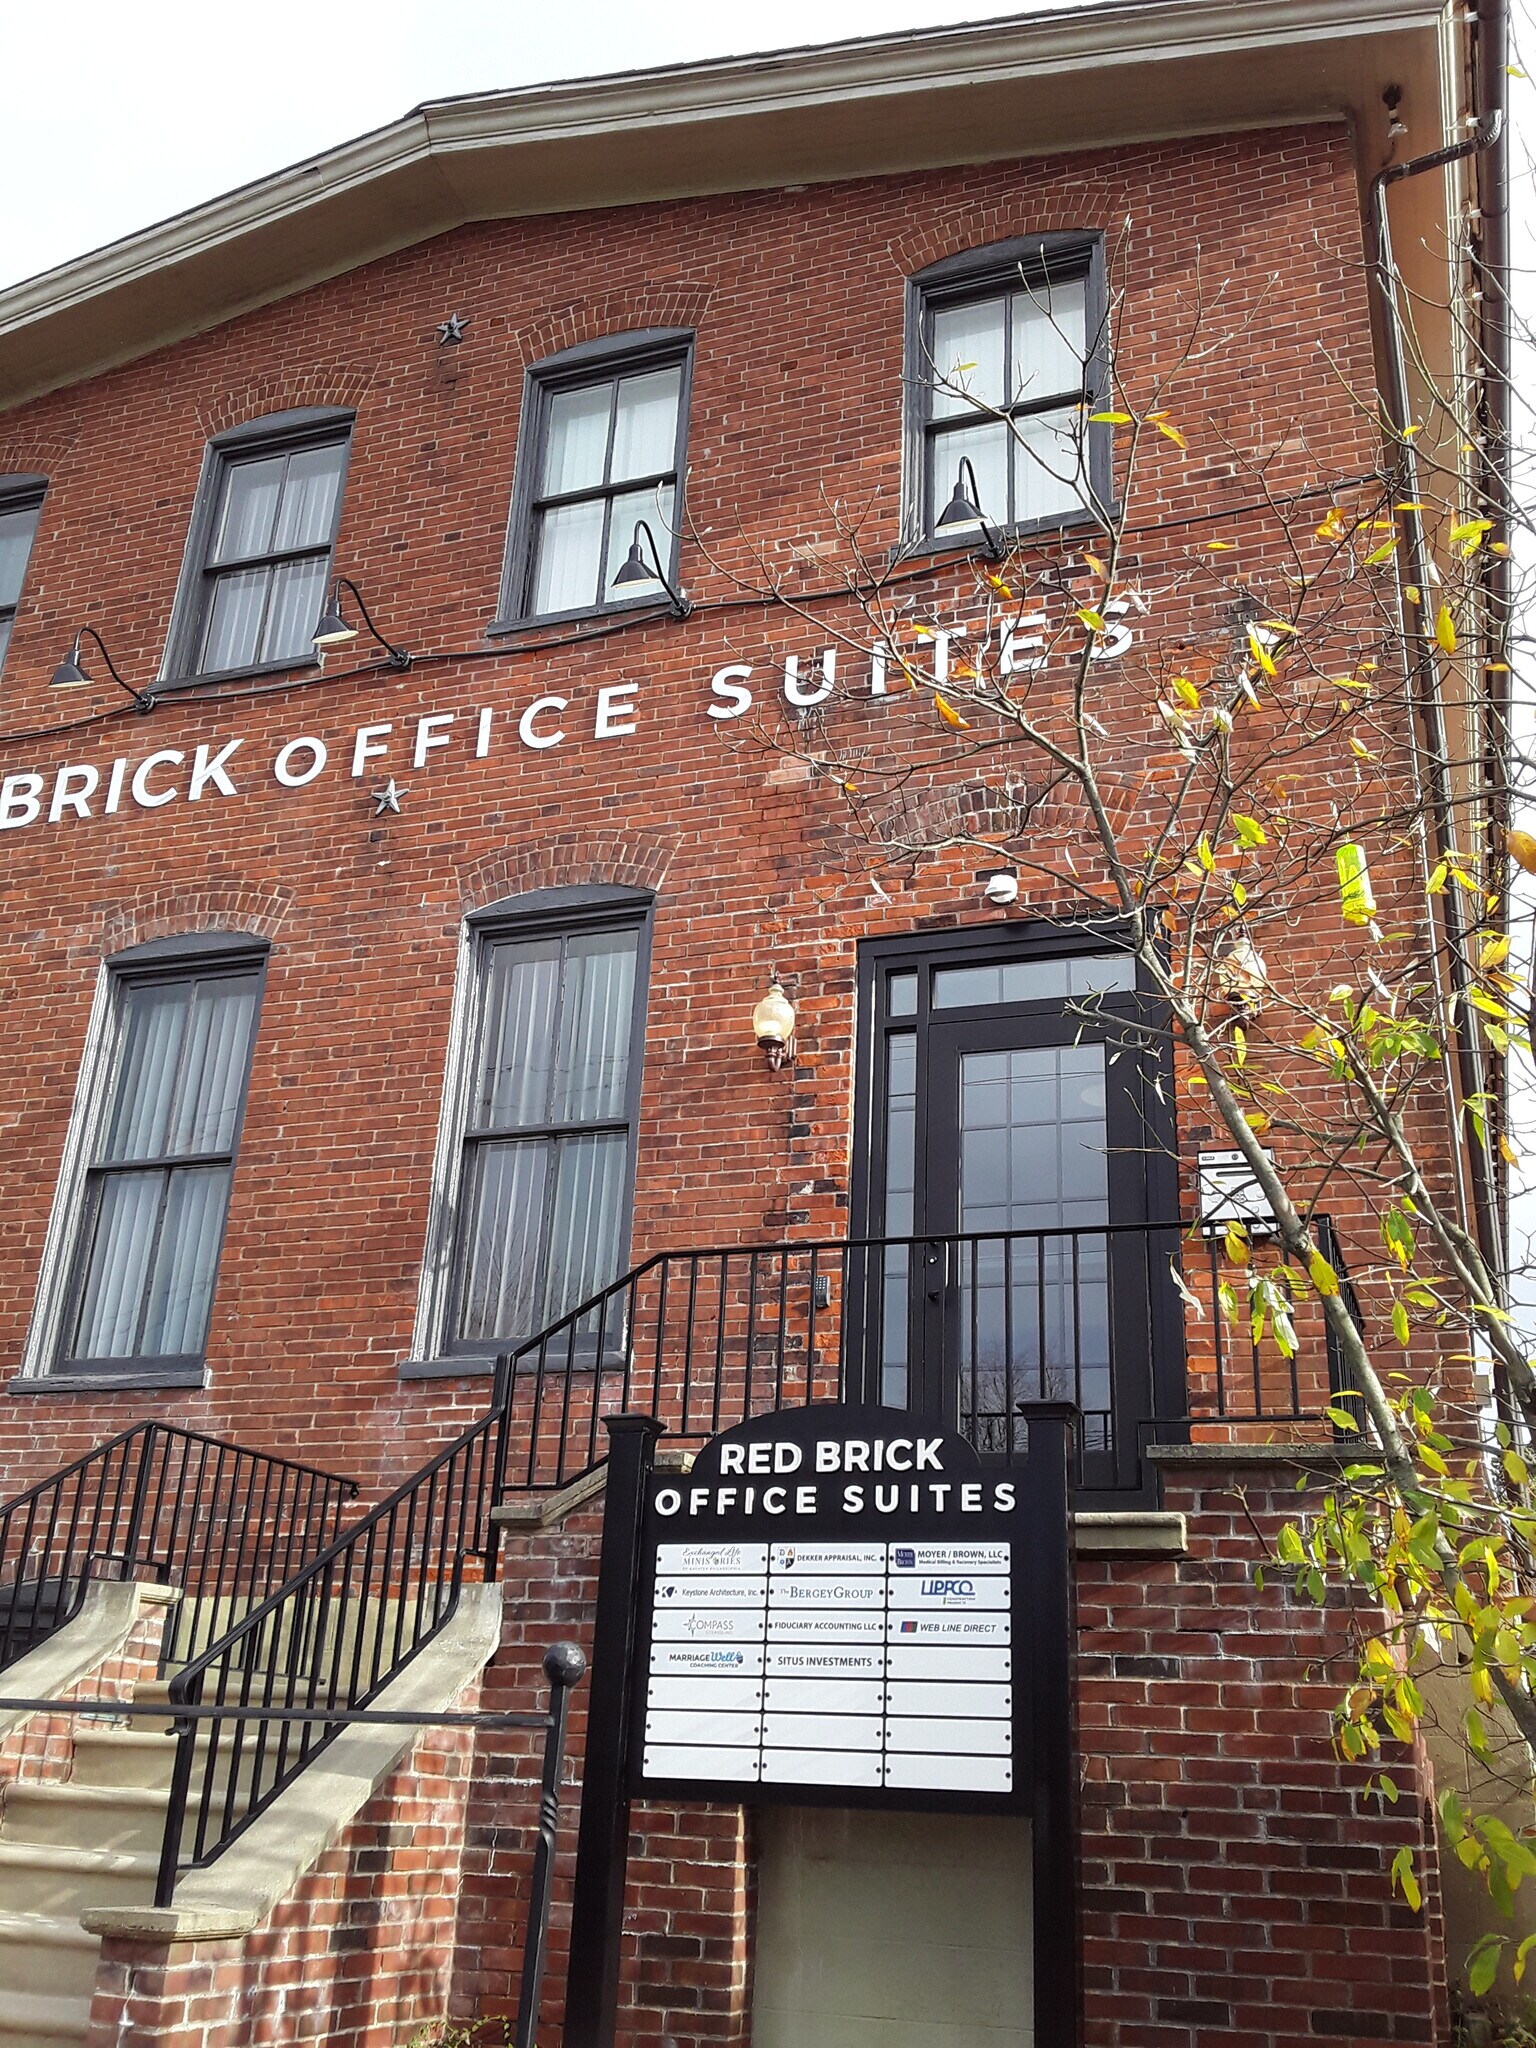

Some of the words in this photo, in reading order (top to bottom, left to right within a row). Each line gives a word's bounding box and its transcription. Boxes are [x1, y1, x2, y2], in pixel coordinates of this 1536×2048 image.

[0, 738, 244, 830] BRICK
[274, 682, 639, 788] OFFICE
[706, 600, 1133, 720] SUITES
[720, 1442, 803, 1475] RED
[815, 1438, 944, 1473] BRICK
[654, 1486, 818, 1516] OFFICE
[842, 1483, 1016, 1514] SUITES
[823, 1554, 862, 1562] APPRAISAL,
[917, 1550, 947, 1558] MOYER
[953, 1551, 987, 1559] BROWN,
[683, 1557, 741, 1566] MINISRIES
[682, 1589, 709, 1598] Keystone
[709, 1589, 747, 1597] Architecture,
[689, 1619, 734, 1631] COMPASS
[774, 1621, 813, 1629] FIDUCIARY
[814, 1622, 862, 1630] ACCOUNTING
[920, 1623, 940, 1632] WEB
[941, 1624, 962, 1632] LINE
[963, 1624, 997, 1633] DIRECT
[669, 1653, 711, 1662] MARRIAGE
[710, 1651, 736, 1662] Well
[777, 1656, 804, 1666] SITUS
[806, 1656, 873, 1667] INVESTMENTS
